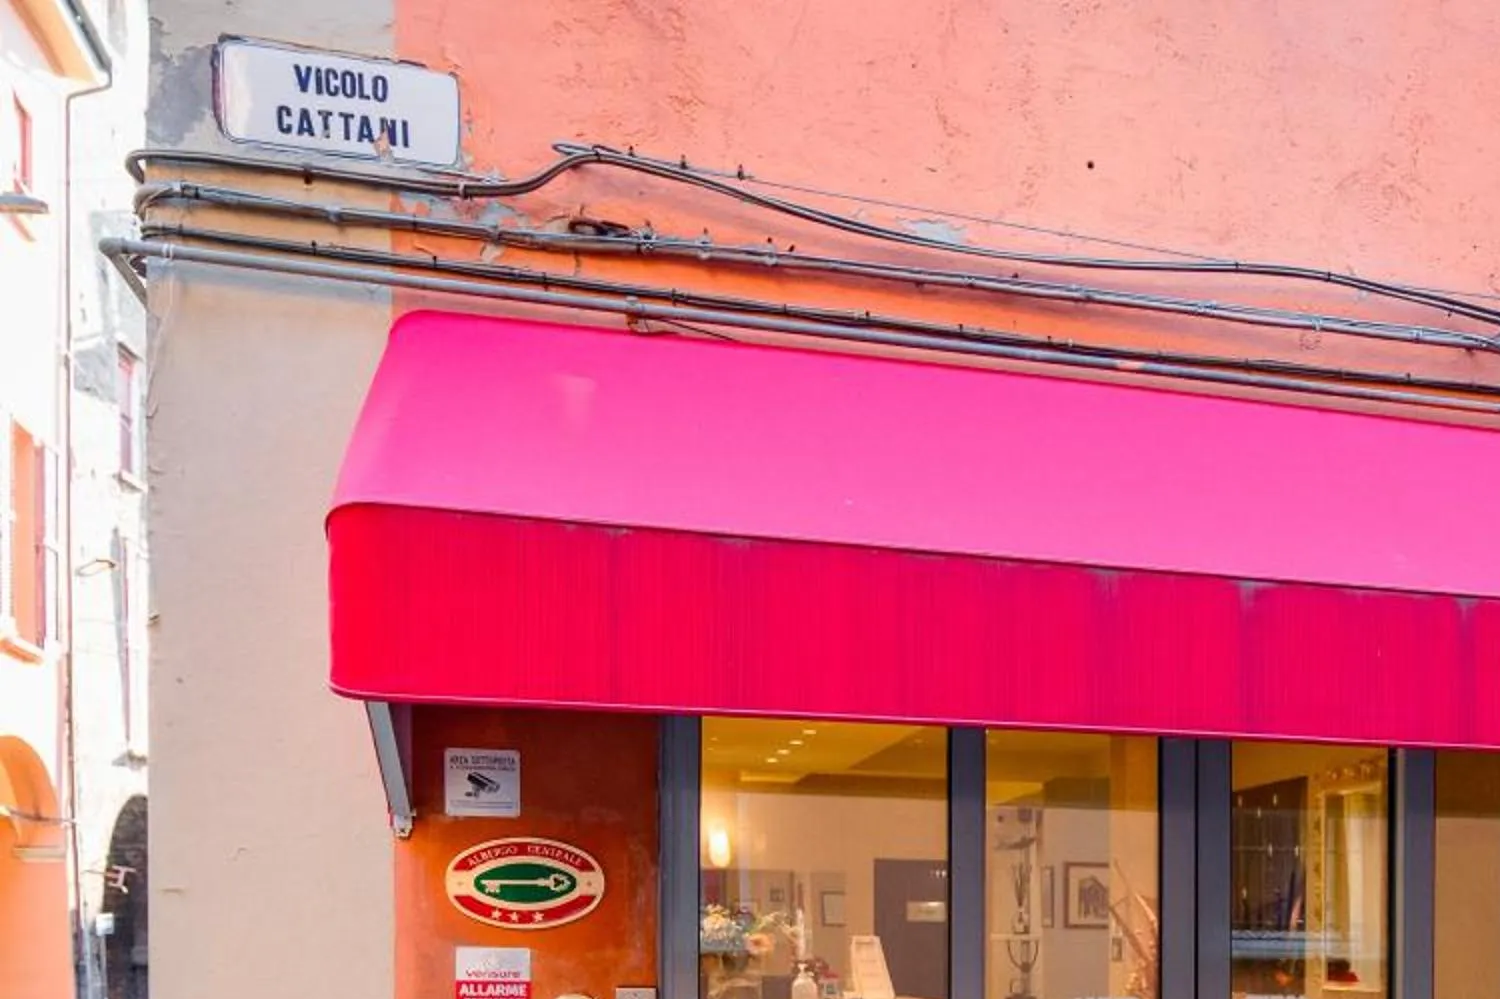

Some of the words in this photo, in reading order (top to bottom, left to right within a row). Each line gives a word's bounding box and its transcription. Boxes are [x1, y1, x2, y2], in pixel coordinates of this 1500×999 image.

[293, 63, 389, 103] VICOLO
[276, 105, 410, 149] CATTANI
[467, 845, 518, 867] ALBERGO
[527, 844, 582, 867] CENTRALE
[459, 983, 528, 997] ALLARME
